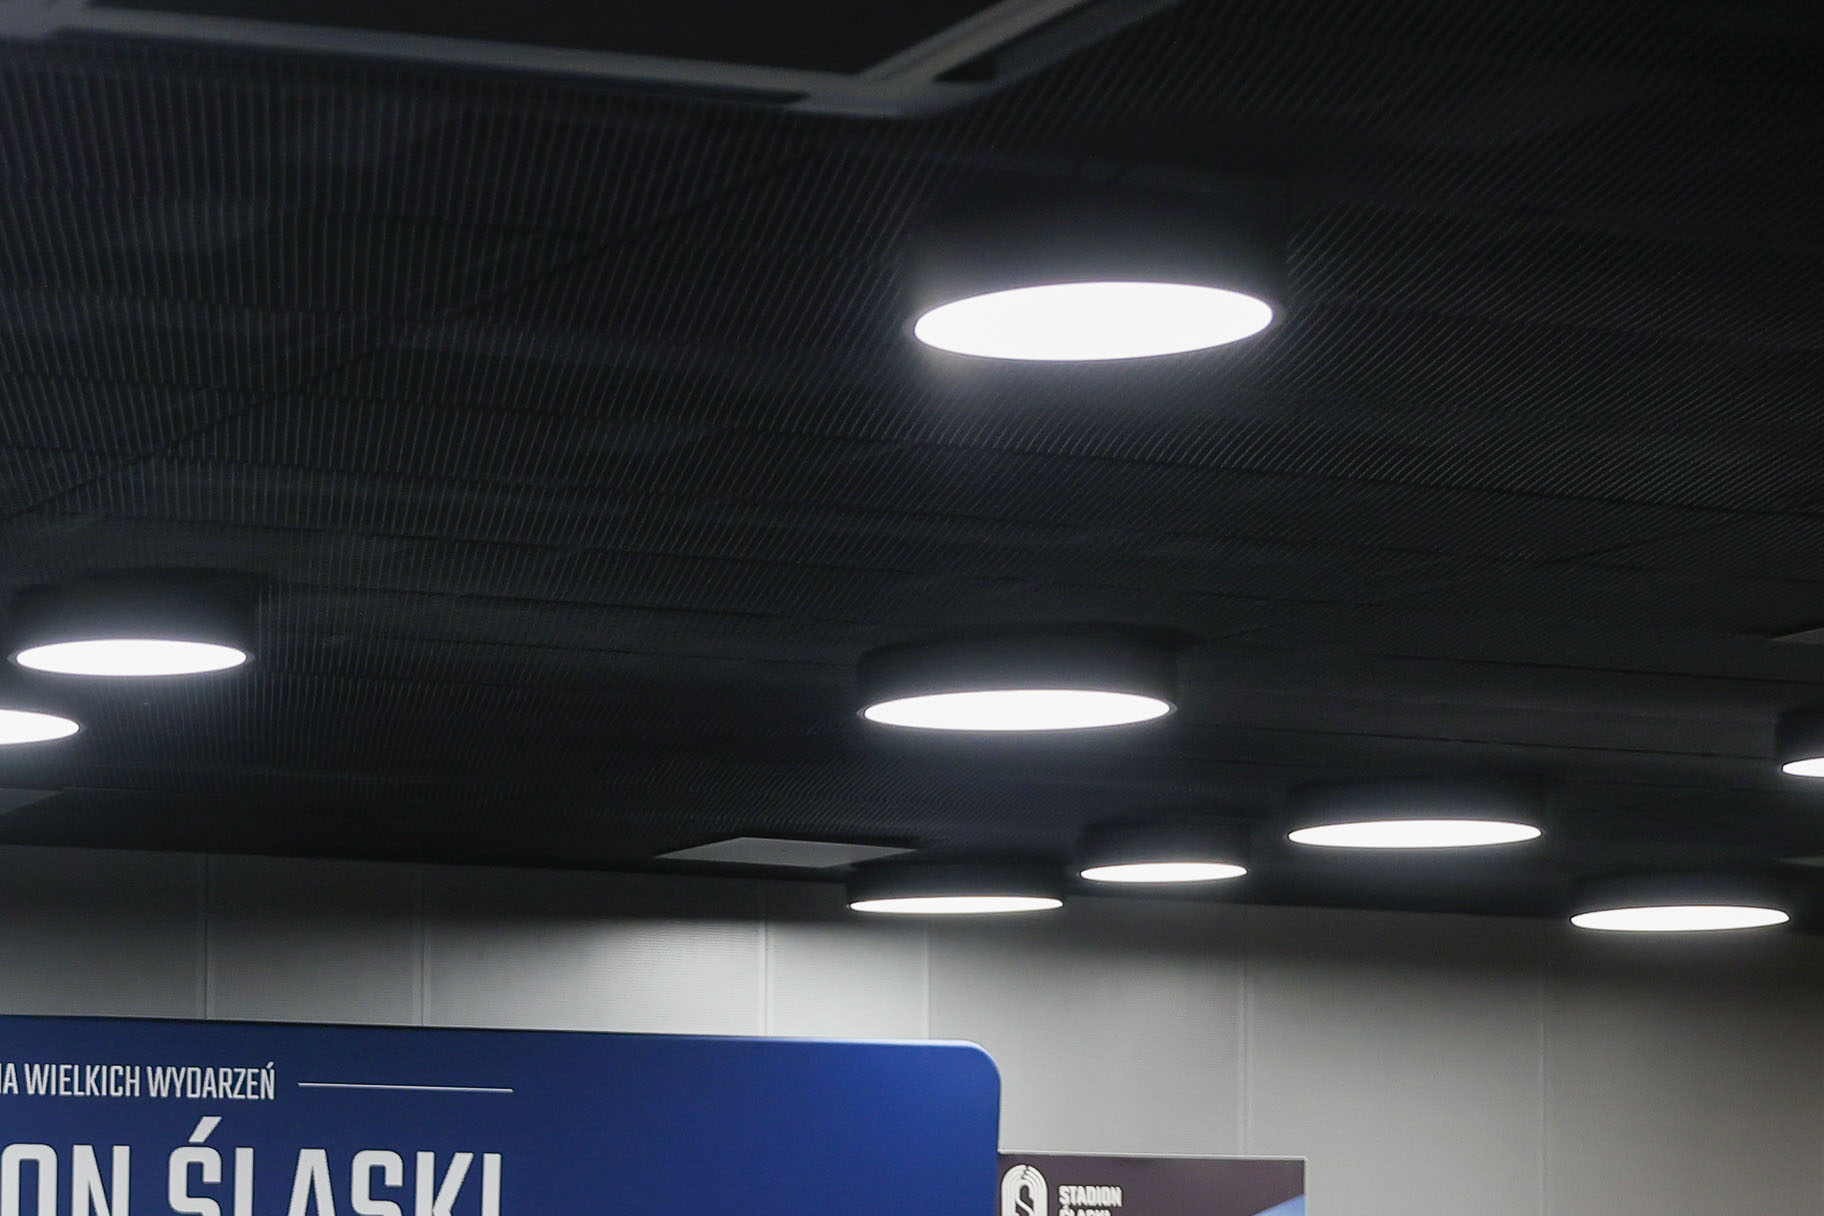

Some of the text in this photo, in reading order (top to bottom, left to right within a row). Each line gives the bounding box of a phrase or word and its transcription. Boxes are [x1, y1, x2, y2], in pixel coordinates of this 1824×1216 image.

[24, 1062, 140, 1097] WIELKICH
[147, 1061, 275, 1100] WYDARZEŃ
[1058, 1185, 1122, 1208] STADION
